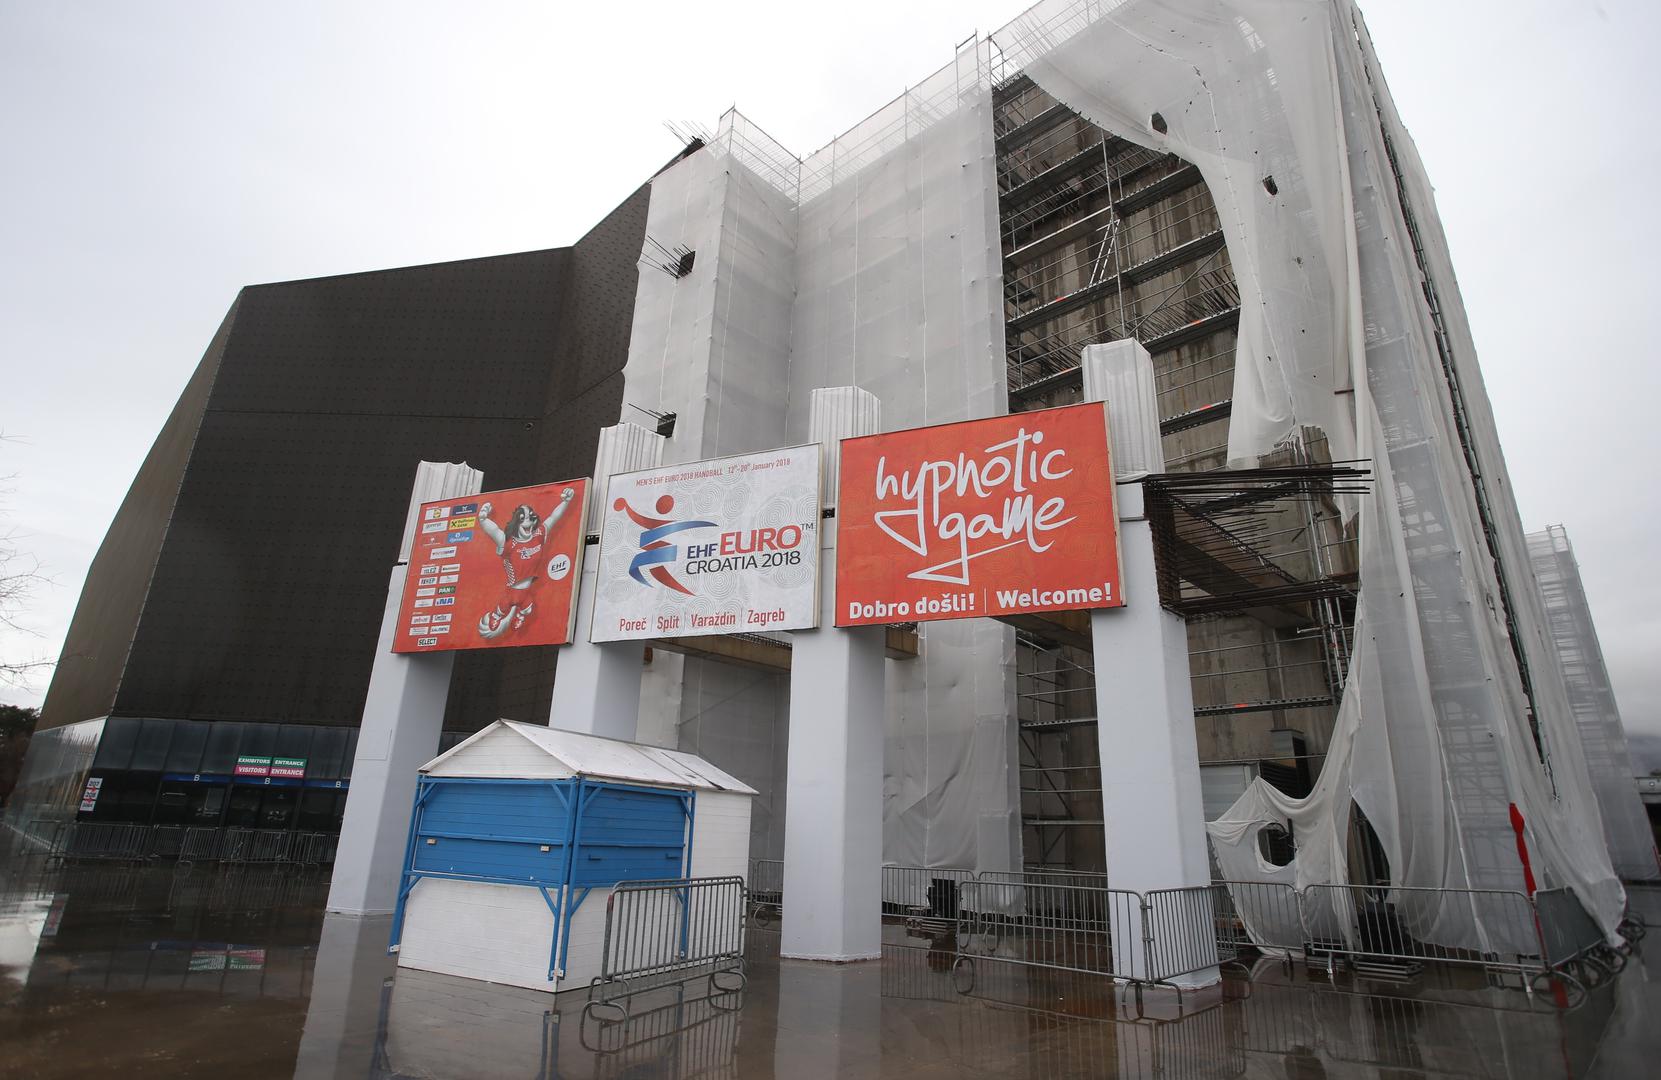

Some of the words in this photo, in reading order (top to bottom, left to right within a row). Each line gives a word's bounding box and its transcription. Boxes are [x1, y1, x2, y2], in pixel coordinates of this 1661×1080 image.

[653, 476, 664, 485] EHF
[665, 474, 680, 483] EURO
[680, 472, 694, 481] 2018
[694, 468, 723, 479] HANDBALL
[751, 461, 774, 471] January
[776, 458, 791, 467] 2018
[874, 428, 1073, 556] hypnotic
[687, 544, 718, 559] EHF
[720, 525, 802, 556] EURO
[907, 494, 1078, 586] game
[551, 560, 567, 571] EHF
[686, 555, 758, 575] CROATIA
[762, 550, 801, 568] 2018
[849, 598, 909, 619] Dobro
[915, 592, 975, 615] došli!
[996, 583, 1112, 609] Welcome!
[619, 617, 647, 632] Poreč
[657, 616, 680, 632] Split
[691, 612, 736, 628] Varaždin
[747, 608, 785, 626] Zagreb
[418, 638, 436, 646] SELECT
[194, 774, 200, 782] B
[271, 768, 304, 776] ENTRANCE
